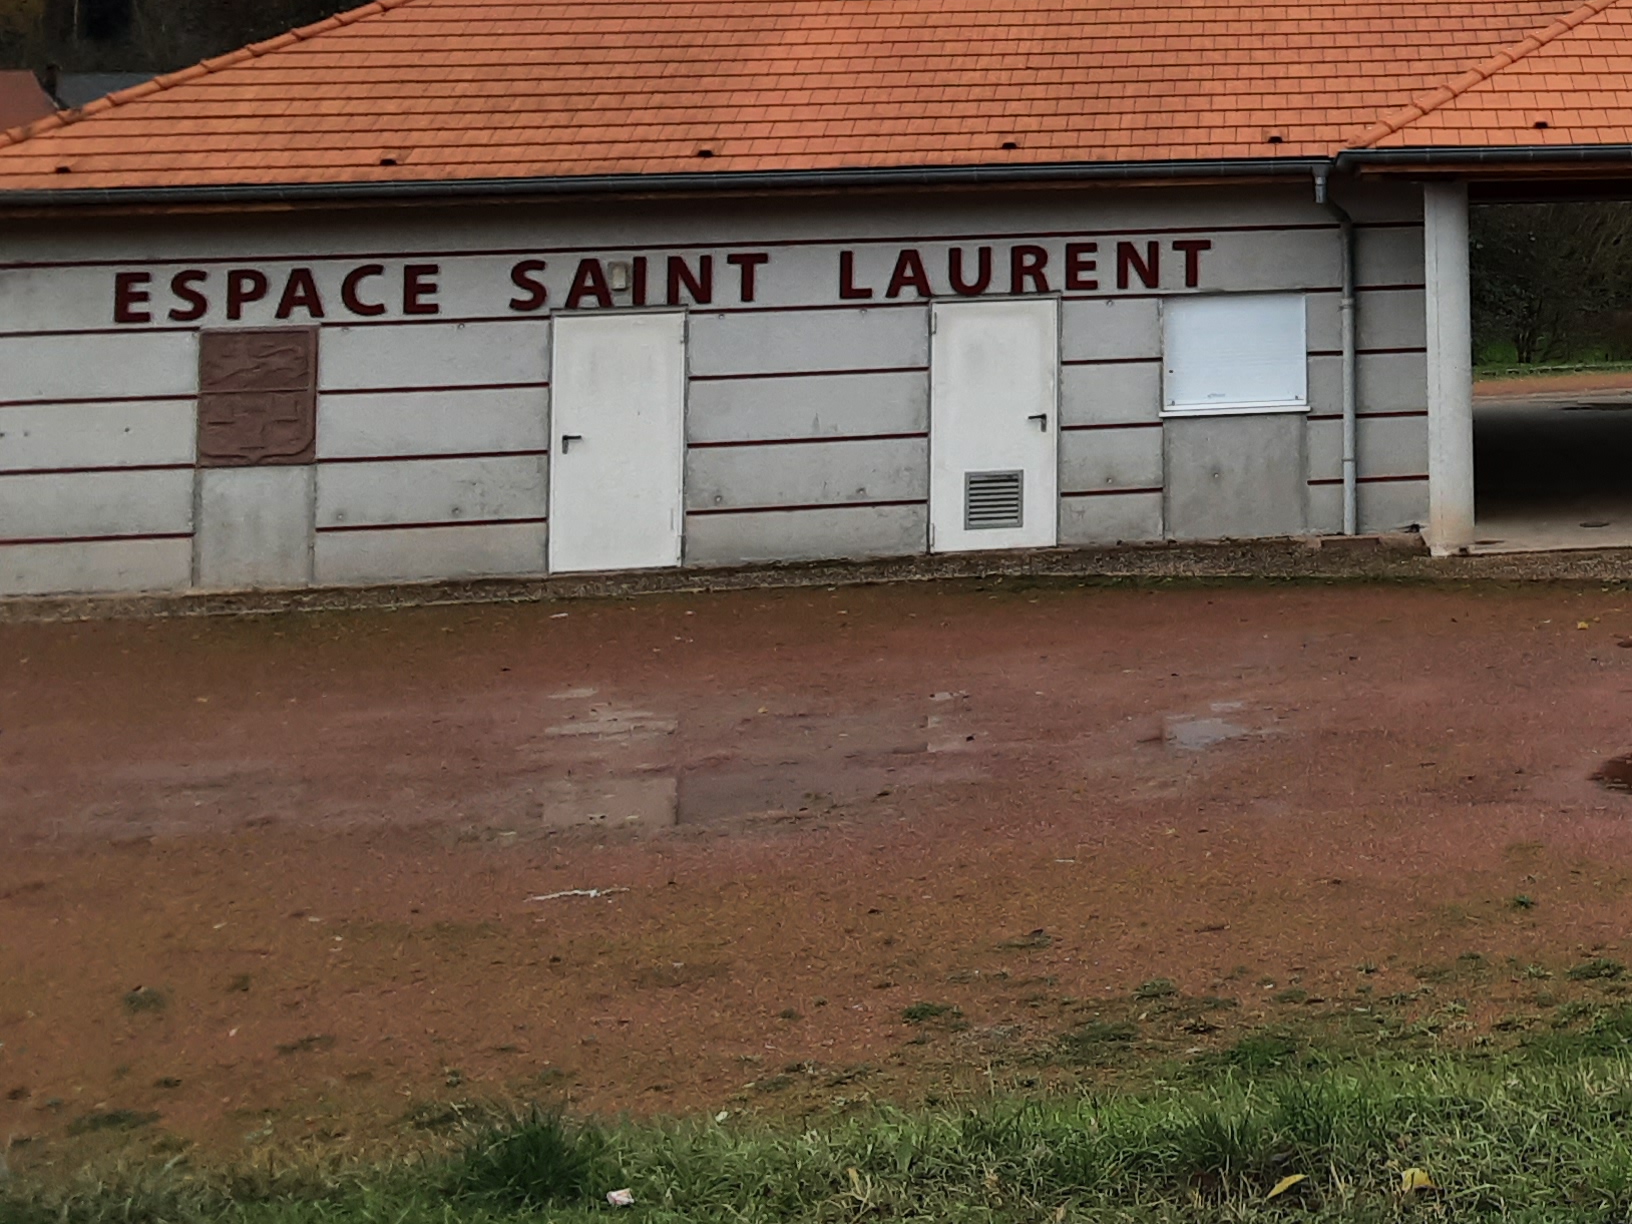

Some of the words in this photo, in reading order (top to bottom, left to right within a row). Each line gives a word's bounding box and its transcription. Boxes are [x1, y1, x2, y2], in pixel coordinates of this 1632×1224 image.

[113, 263, 440, 324] ESPACE
[508, 252, 769, 313] SAINT
[839, 239, 1212, 300] LAURENT
